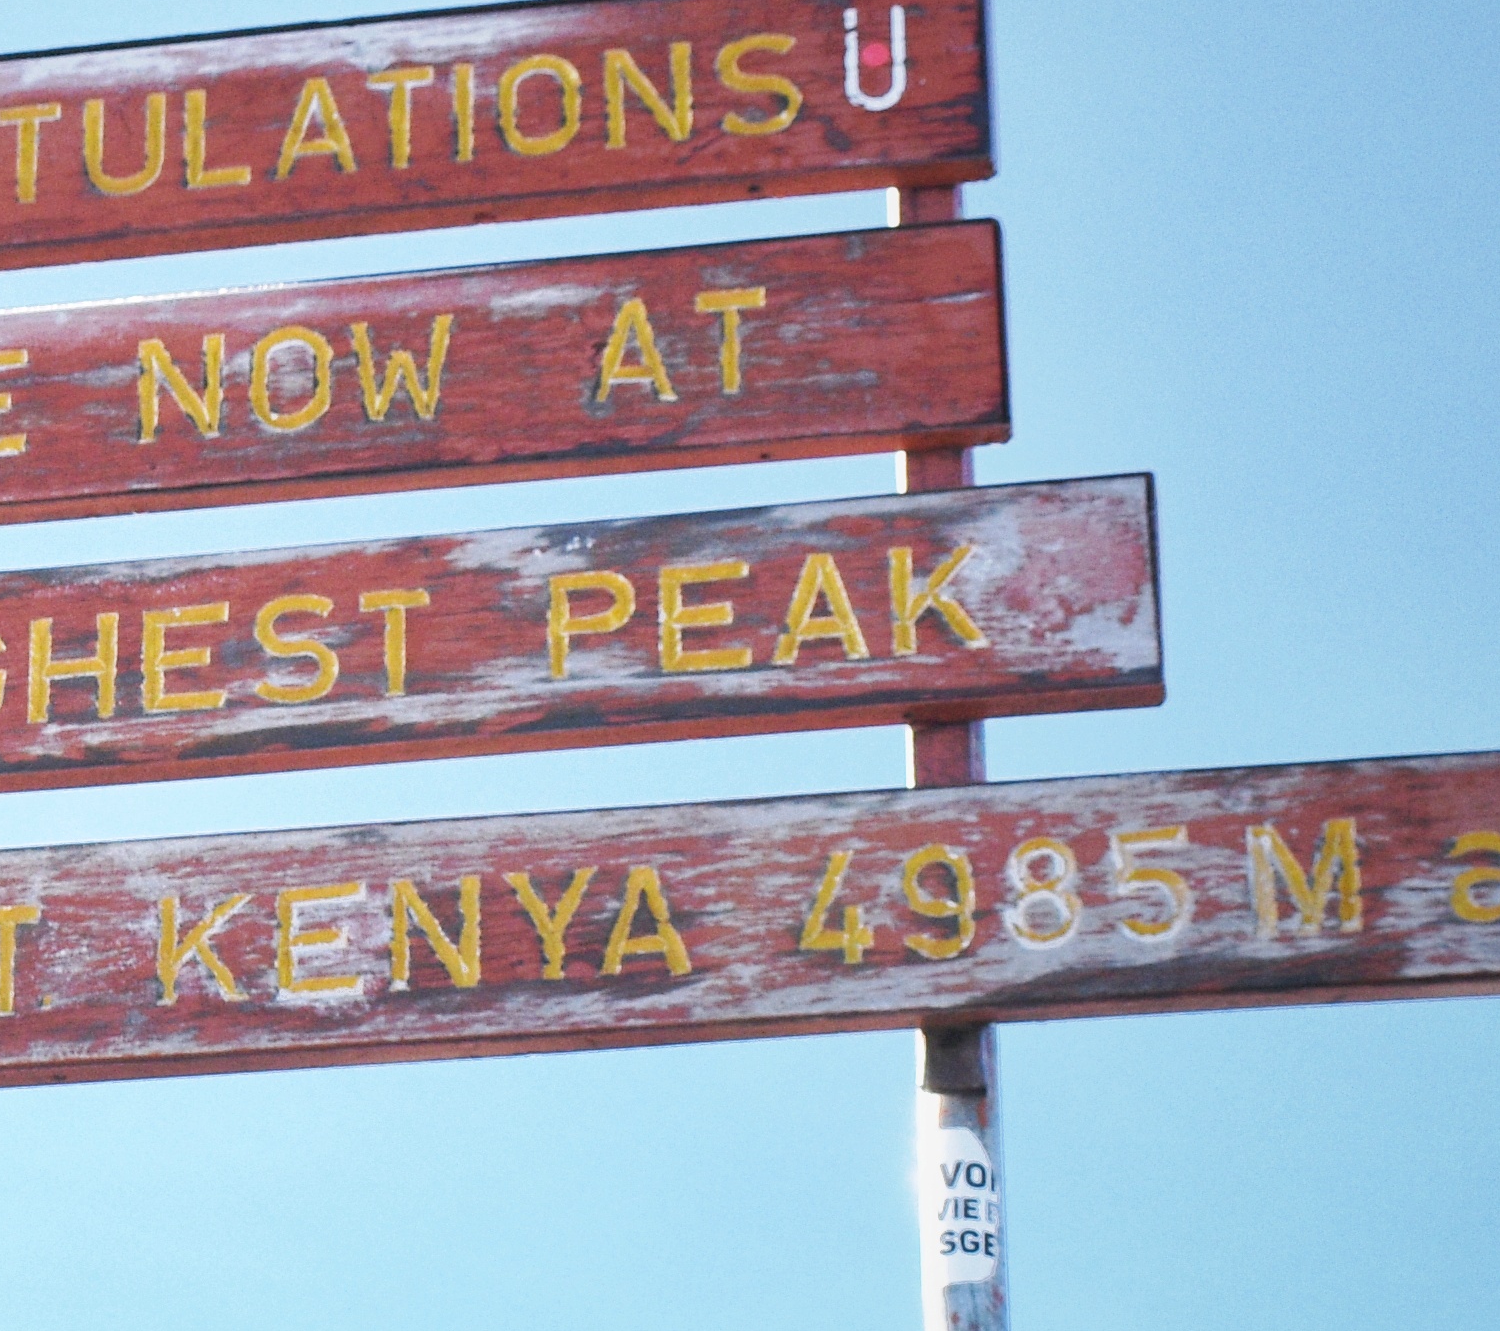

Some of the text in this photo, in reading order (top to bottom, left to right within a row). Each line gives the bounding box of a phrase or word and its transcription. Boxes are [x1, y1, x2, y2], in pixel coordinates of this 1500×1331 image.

[137, 314, 453, 444] NOW
[596, 287, 767, 404] AT
[548, 546, 988, 679] PEAK
[156, 865, 694, 1006] KENYA
